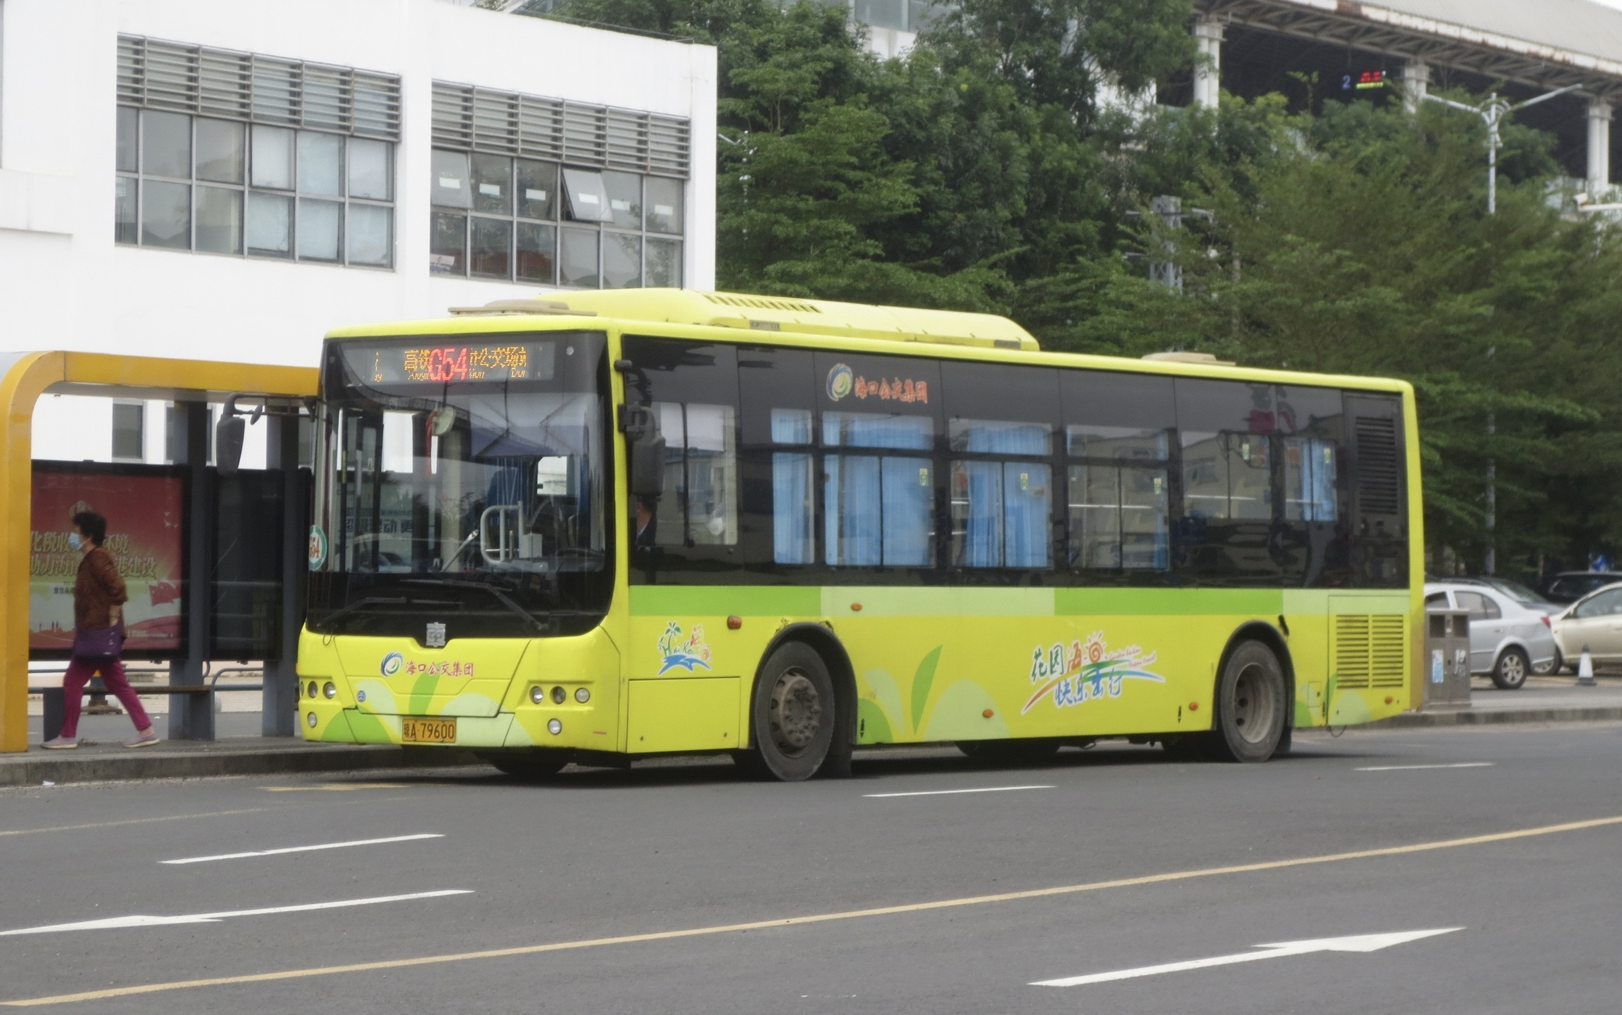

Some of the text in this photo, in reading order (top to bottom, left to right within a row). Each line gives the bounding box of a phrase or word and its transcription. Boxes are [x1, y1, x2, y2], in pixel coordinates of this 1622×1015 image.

[428, 347, 469, 381] G54
[406, 661, 474, 677] 海口公交集团
